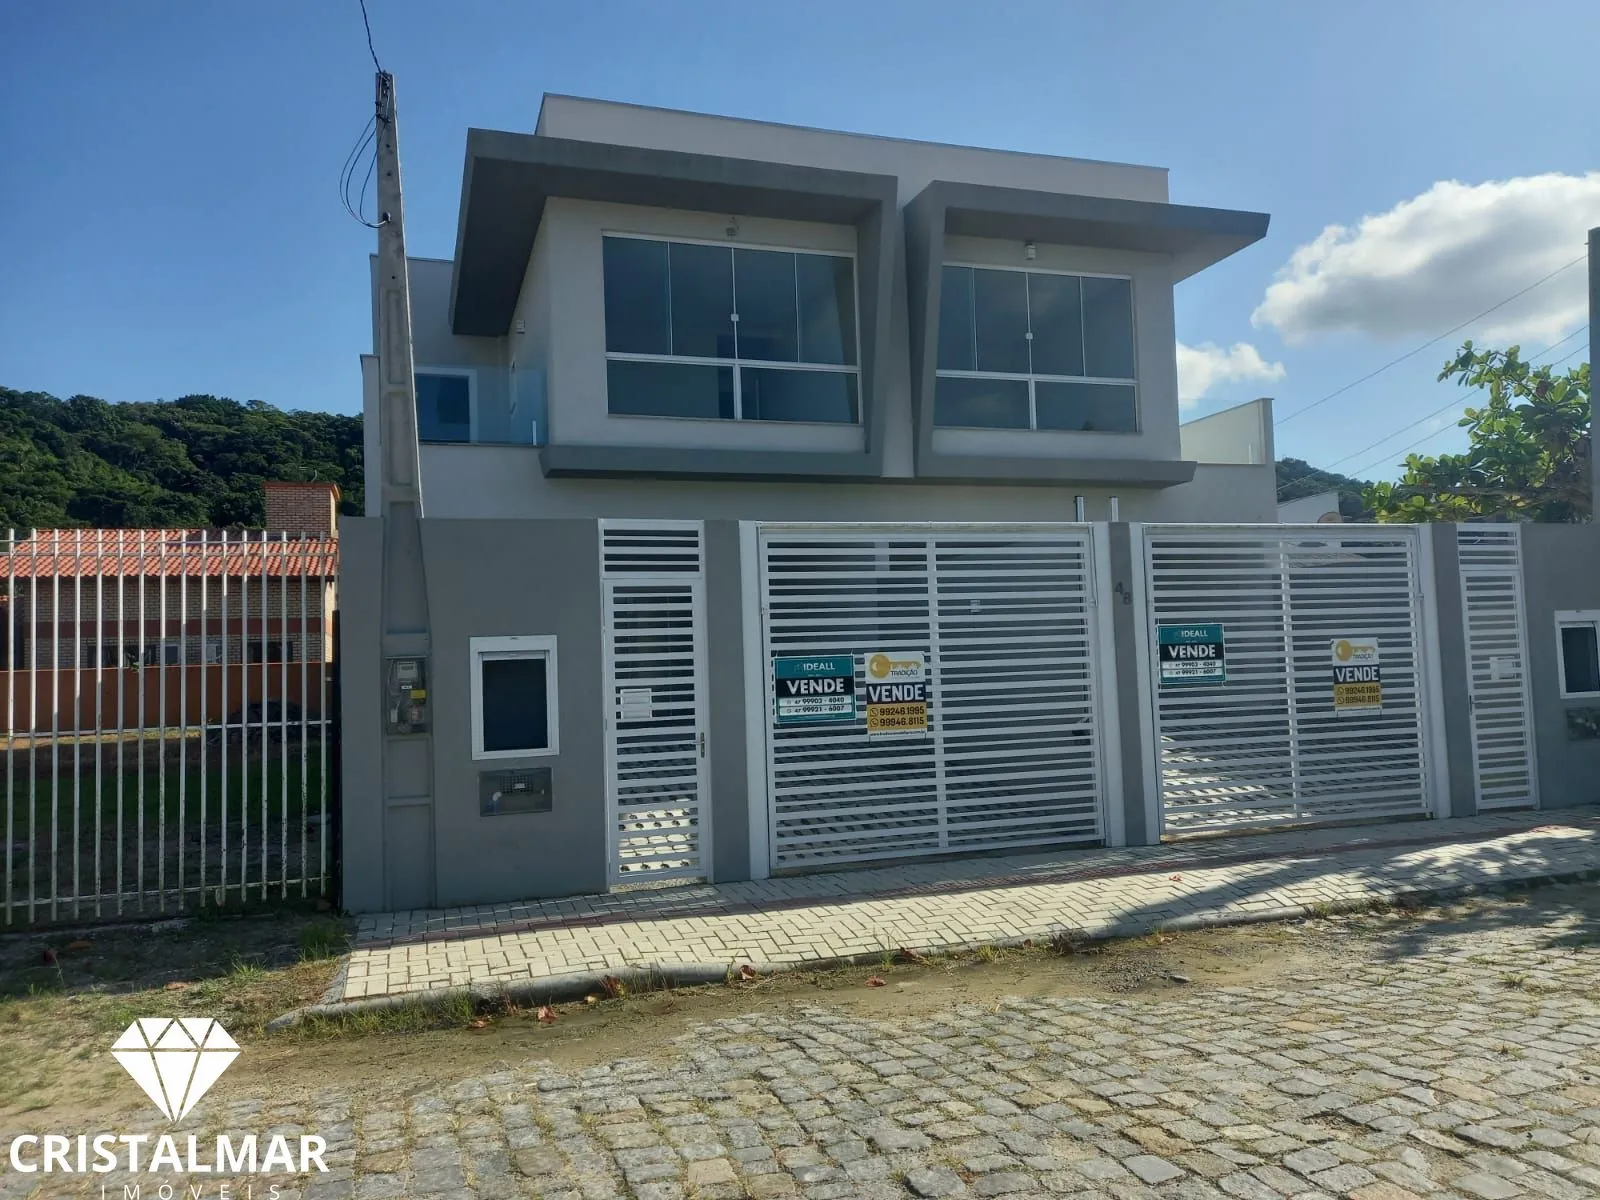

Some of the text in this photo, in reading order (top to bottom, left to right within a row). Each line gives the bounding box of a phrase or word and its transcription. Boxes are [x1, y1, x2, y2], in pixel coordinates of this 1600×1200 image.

[1181, 630, 1208, 638] IDEALL
[1168, 644, 1216, 659] VENDE
[803, 662, 836, 671] IDEALL
[1336, 667, 1379, 682] VENDE
[786, 678, 845, 695] VENDE
[868, 684, 924, 702] VENDE
[879, 706, 925, 716] 99246.1995
